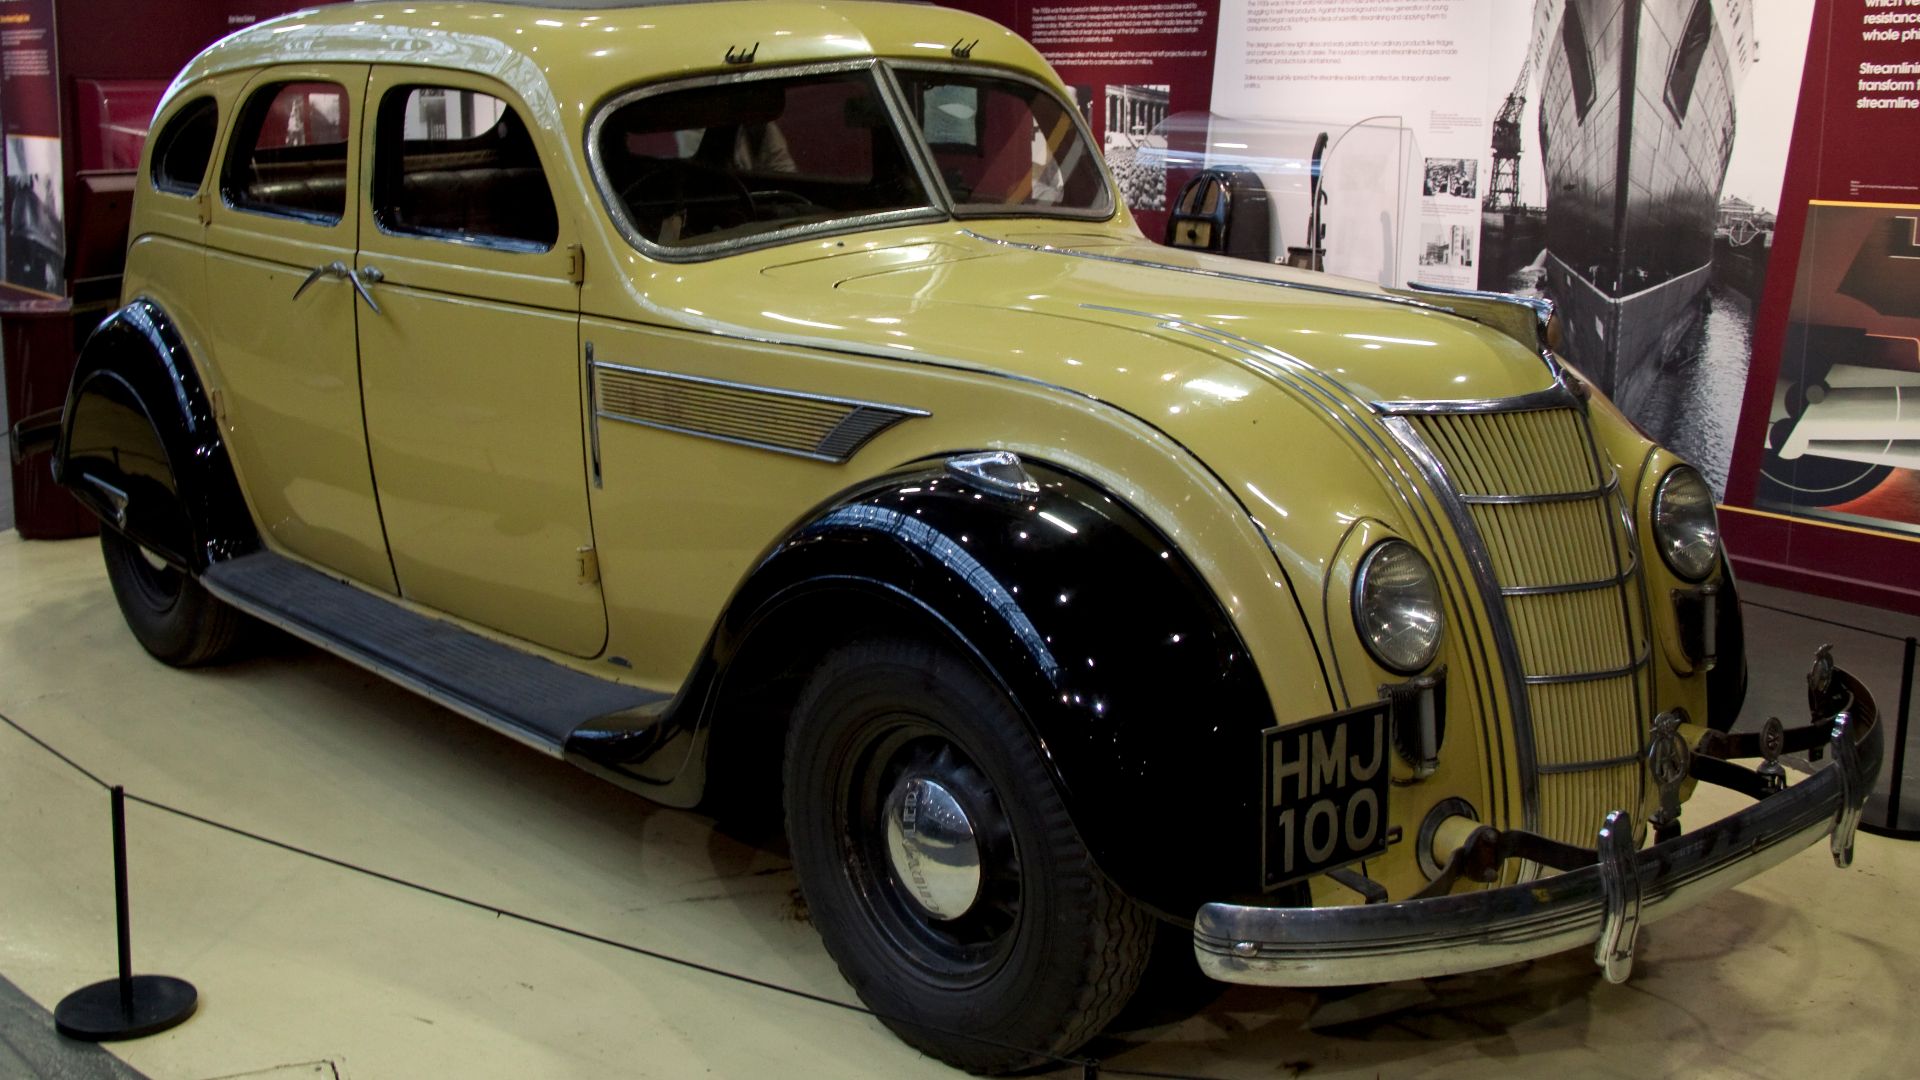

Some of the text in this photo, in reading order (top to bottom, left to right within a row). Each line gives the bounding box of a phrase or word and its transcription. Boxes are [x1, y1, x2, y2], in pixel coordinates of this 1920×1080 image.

[1862, 29, 1899, 41] whole
[1858, 79, 1914, 91] transform
[1856, 96, 1920, 108] streamline
[1273, 714, 1383, 807] HMJ
[1279, 787, 1379, 873] 100
